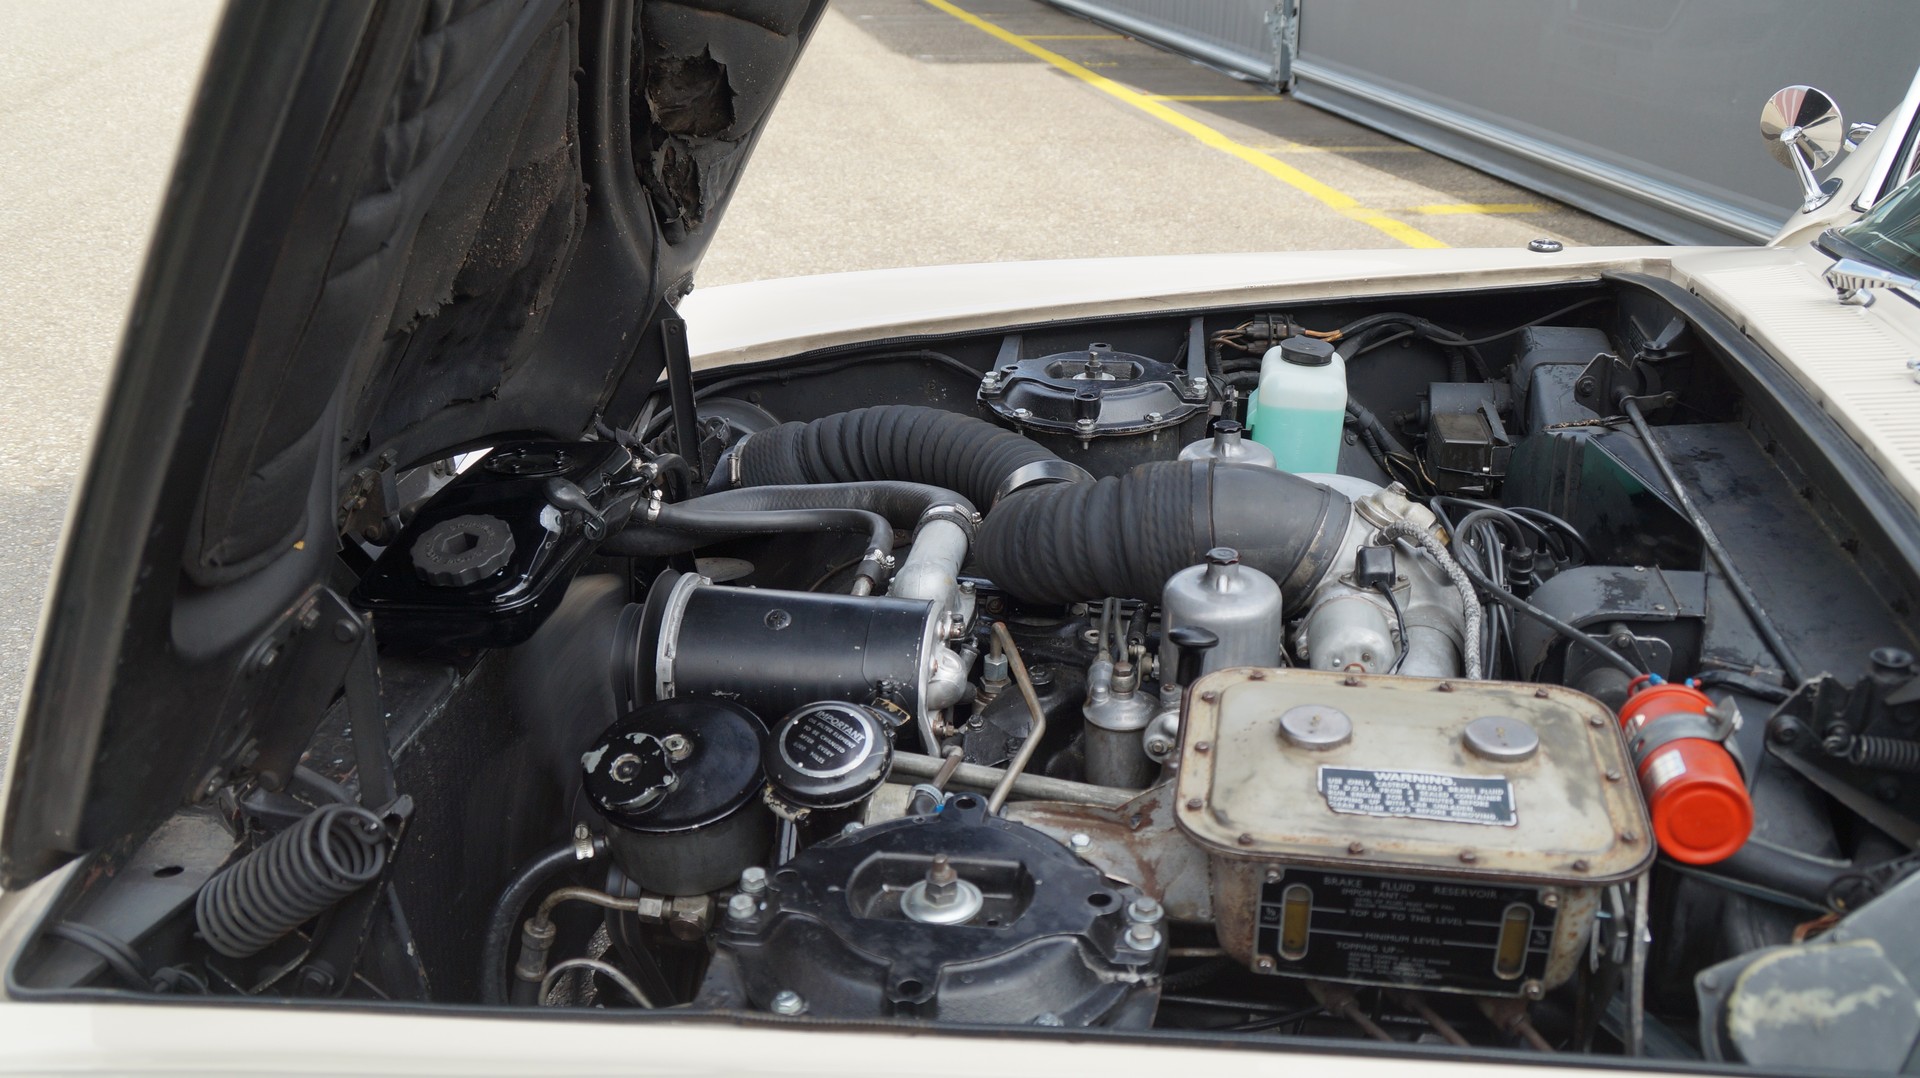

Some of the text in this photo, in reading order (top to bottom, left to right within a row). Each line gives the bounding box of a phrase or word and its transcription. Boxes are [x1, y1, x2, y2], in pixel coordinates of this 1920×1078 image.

[808, 717, 857, 749] OIL FILTER ELEMENT
[816, 710, 866, 741] IMPORTANT
[799, 733, 835, 758] AFTER EVERY
[820, 734, 846, 754] CHANGED
[809, 752, 826, 764] MILES
[1346, 779, 1371, 787] ONLY
[1374, 781, 1411, 790] CASTROL
[1479, 788, 1504, 796] FLUID
[1379, 787, 1403, 795] FROM
[1419, 790, 1449, 798] SEALED
[1453, 793, 1502, 802] CONTAINER
[1328, 796, 1364, 804] TOPPING
[1350, 791, 1381, 799] ENGINE
[1419, 797, 1454, 805] MINUTES
[1458, 800, 1490, 808] BEFORE
[1328, 801, 1355, 809] CLEAN
[1359, 804, 1384, 812] FILLER
[1415, 808, 1446, 816] BEFORE
[1323, 877, 1498, 899] BRAKE FLUID RESERVOIR
[1349, 909, 1463, 926] TOP UP TO THIS LEVEL
[1336, 942, 1378, 953] TOPPING
[1364, 932, 1441, 946] MINIMUM LEVEL
